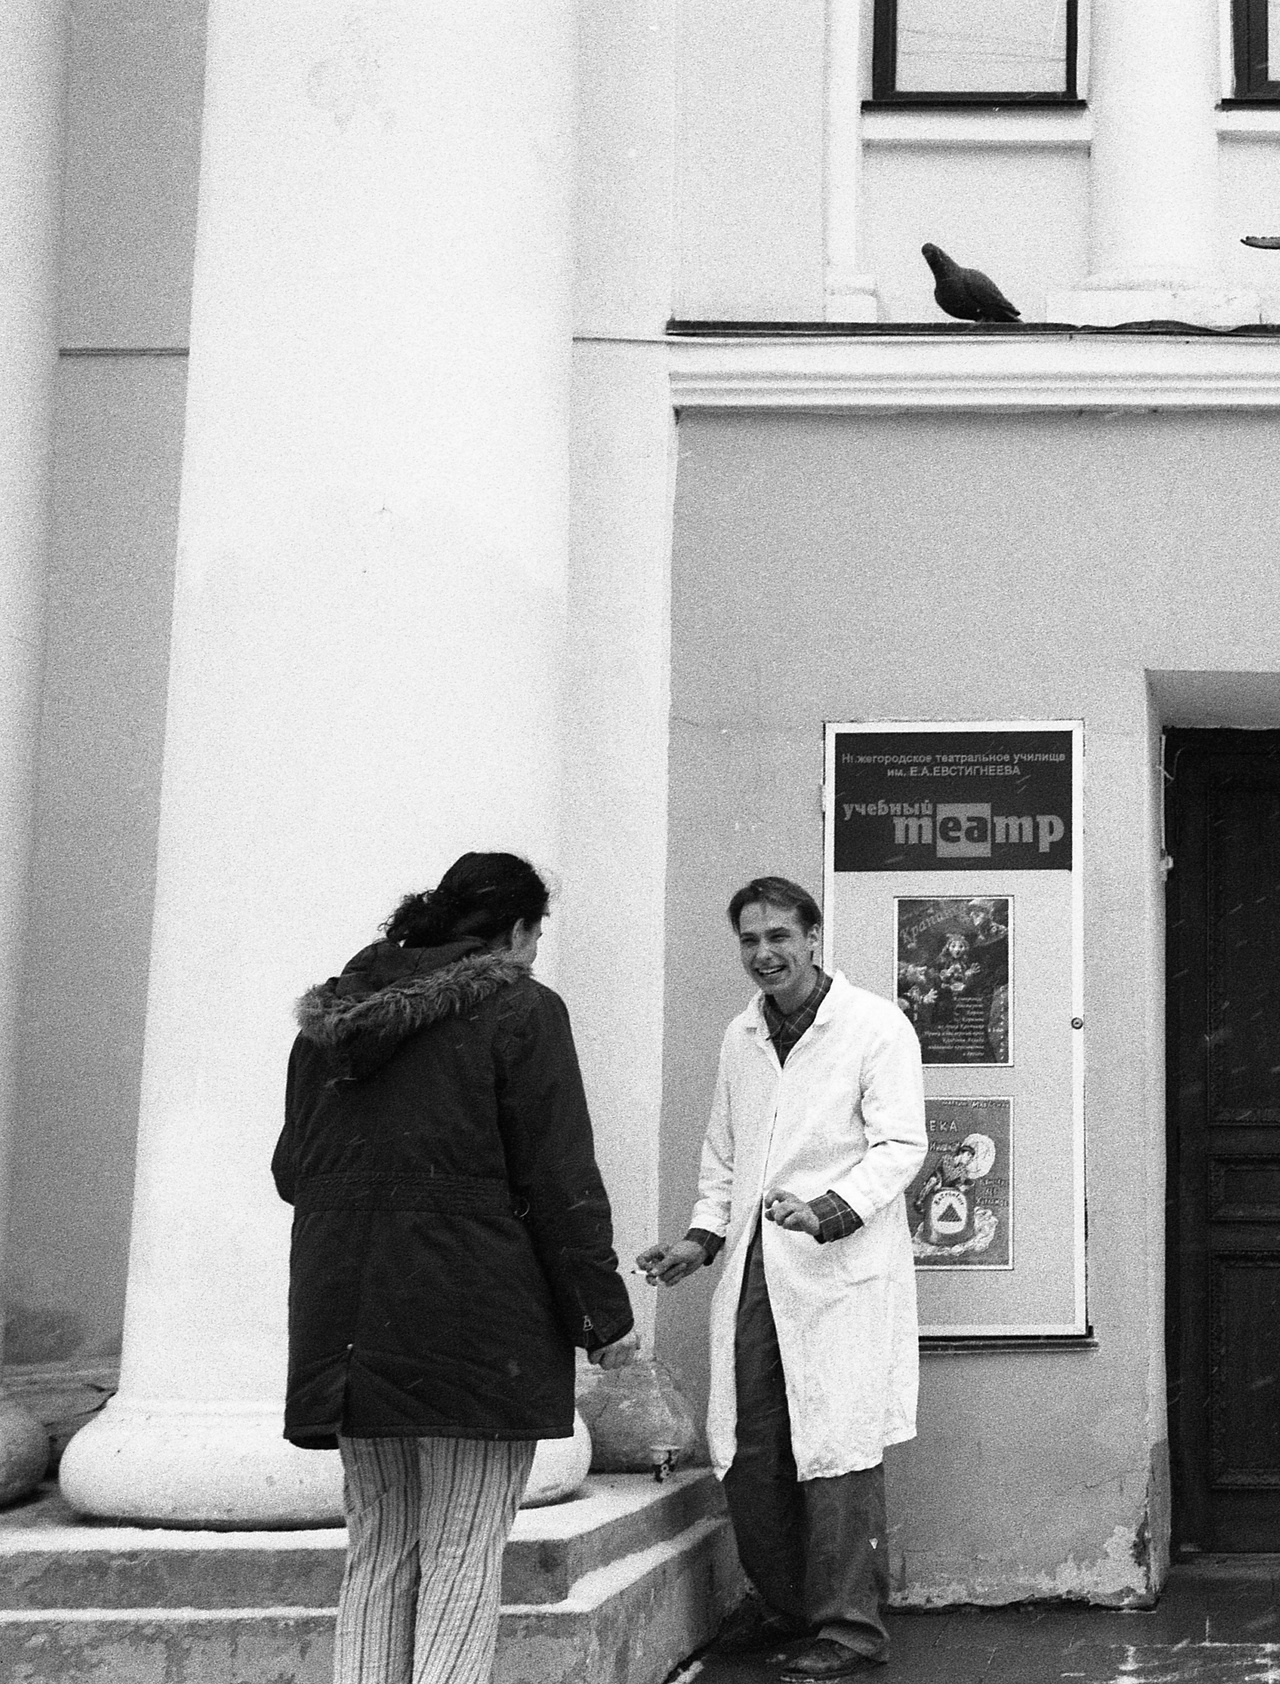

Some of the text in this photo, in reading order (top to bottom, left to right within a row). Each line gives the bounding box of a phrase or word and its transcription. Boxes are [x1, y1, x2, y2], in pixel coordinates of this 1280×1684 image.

[936, 752, 1010, 764] театральное
[1013, 751, 1066, 764] училище
[843, 799, 934, 820] учебный
[893, 814, 1065, 853] театр
